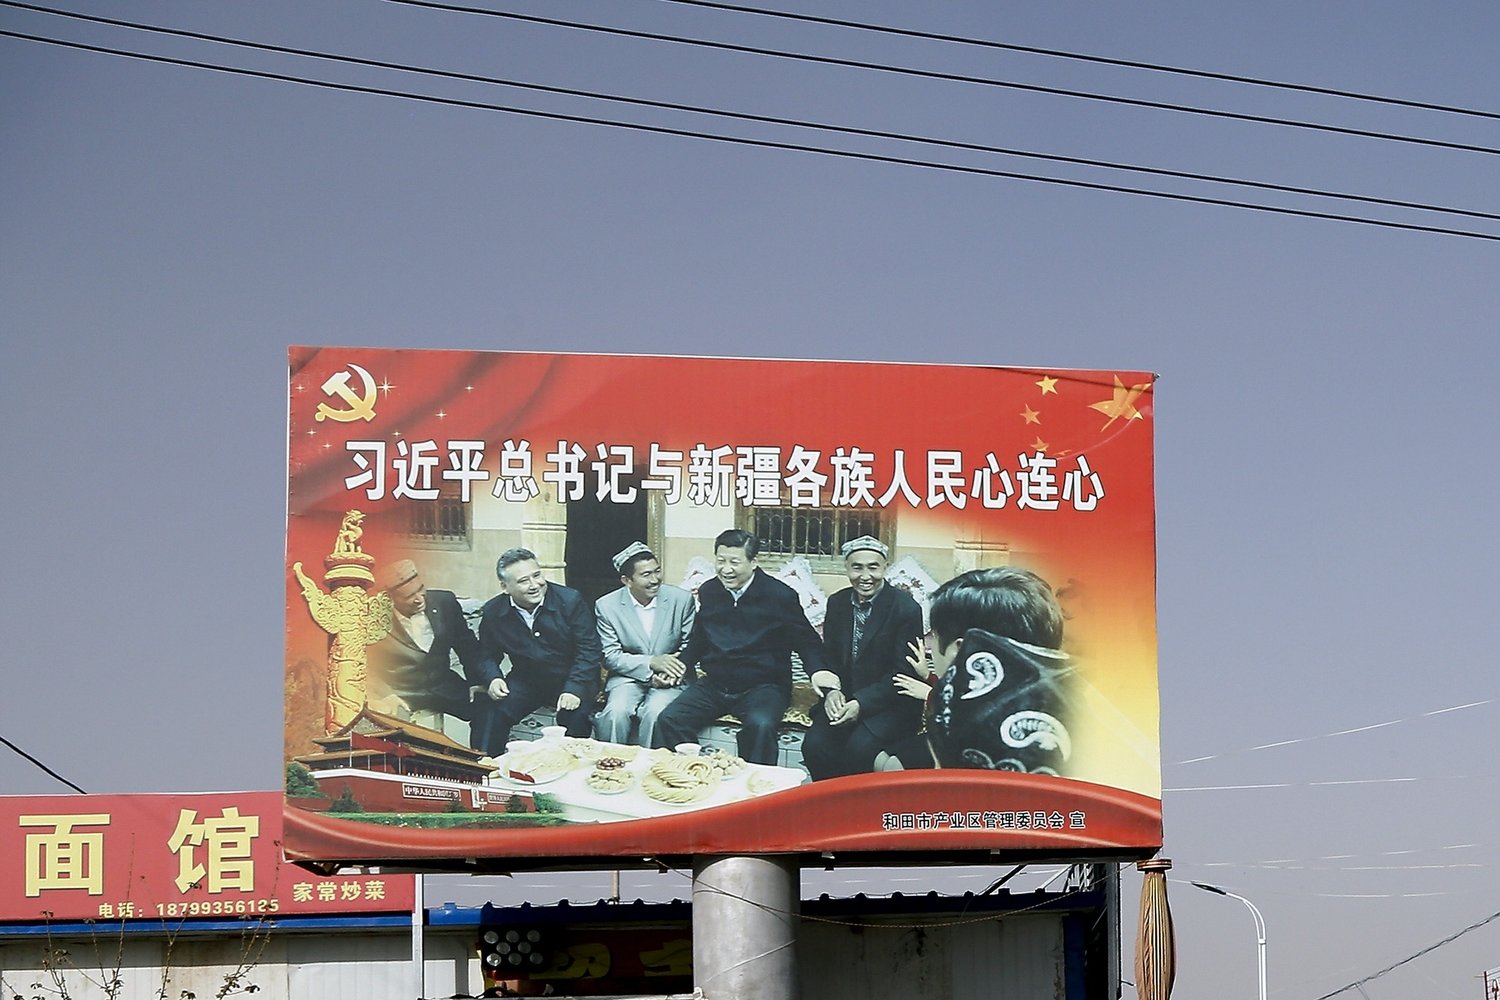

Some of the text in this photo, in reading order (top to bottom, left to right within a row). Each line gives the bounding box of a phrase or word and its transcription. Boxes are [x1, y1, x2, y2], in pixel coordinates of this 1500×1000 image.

[343, 438, 1106, 512] 习近平总书记与新疆各族人民心连心
[882, 811, 1086, 831] 和田市产业区管理委员会 宣
[19, 806, 260, 897] 面馆
[293, 880, 385, 902] 家常炒菜
[157, 899, 280, 917] 18799356125
